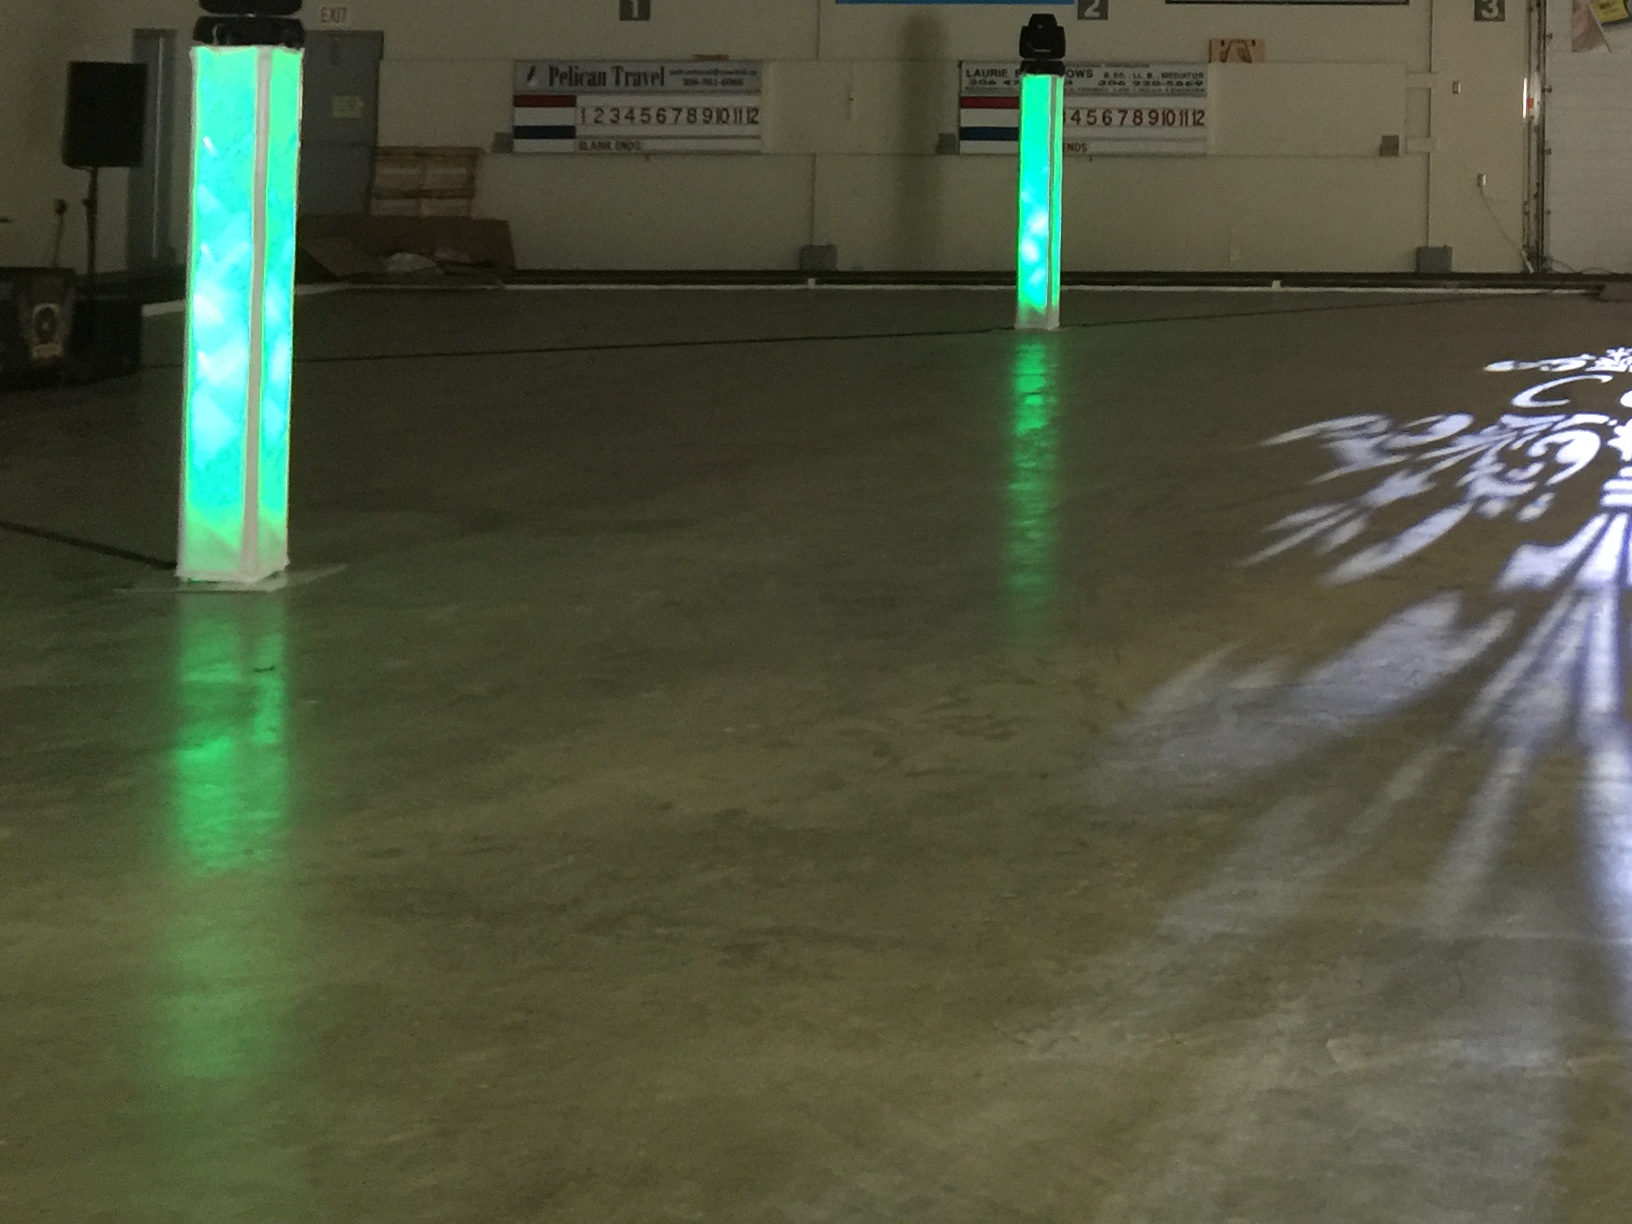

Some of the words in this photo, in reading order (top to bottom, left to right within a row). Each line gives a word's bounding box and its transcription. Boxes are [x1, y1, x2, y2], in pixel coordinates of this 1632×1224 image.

[320, 6, 347, 23] EXIT
[548, 65, 607, 88] Pelican
[611, 65, 666, 87] Travel
[593, 107, 605, 125] 2
[609, 107, 621, 125] 3
[624, 107, 636, 125] 4
[640, 107, 652, 125] 5
[655, 107, 667, 125] 6
[671, 107, 682, 125] 7
[686, 107, 698, 125] 8
[702, 107, 714, 125] 9
[715, 107, 731, 125] 10
[733, 107, 743, 125] 11
[746, 107, 760, 125] 12
[1070, 109, 1081, 126] 4
[1086, 109, 1097, 126] 5
[1101, 109, 1113, 126] 6
[1118, 109, 1129, 126] 7
[1132, 109, 1144, 126] 8
[1148, 109, 1159, 126] 9
[1162, 109, 1176, 126] 10
[1179, 109, 1189, 126] 11
[1191, 109, 1206, 126] 12
[1511, 374, 1613, 408] C
